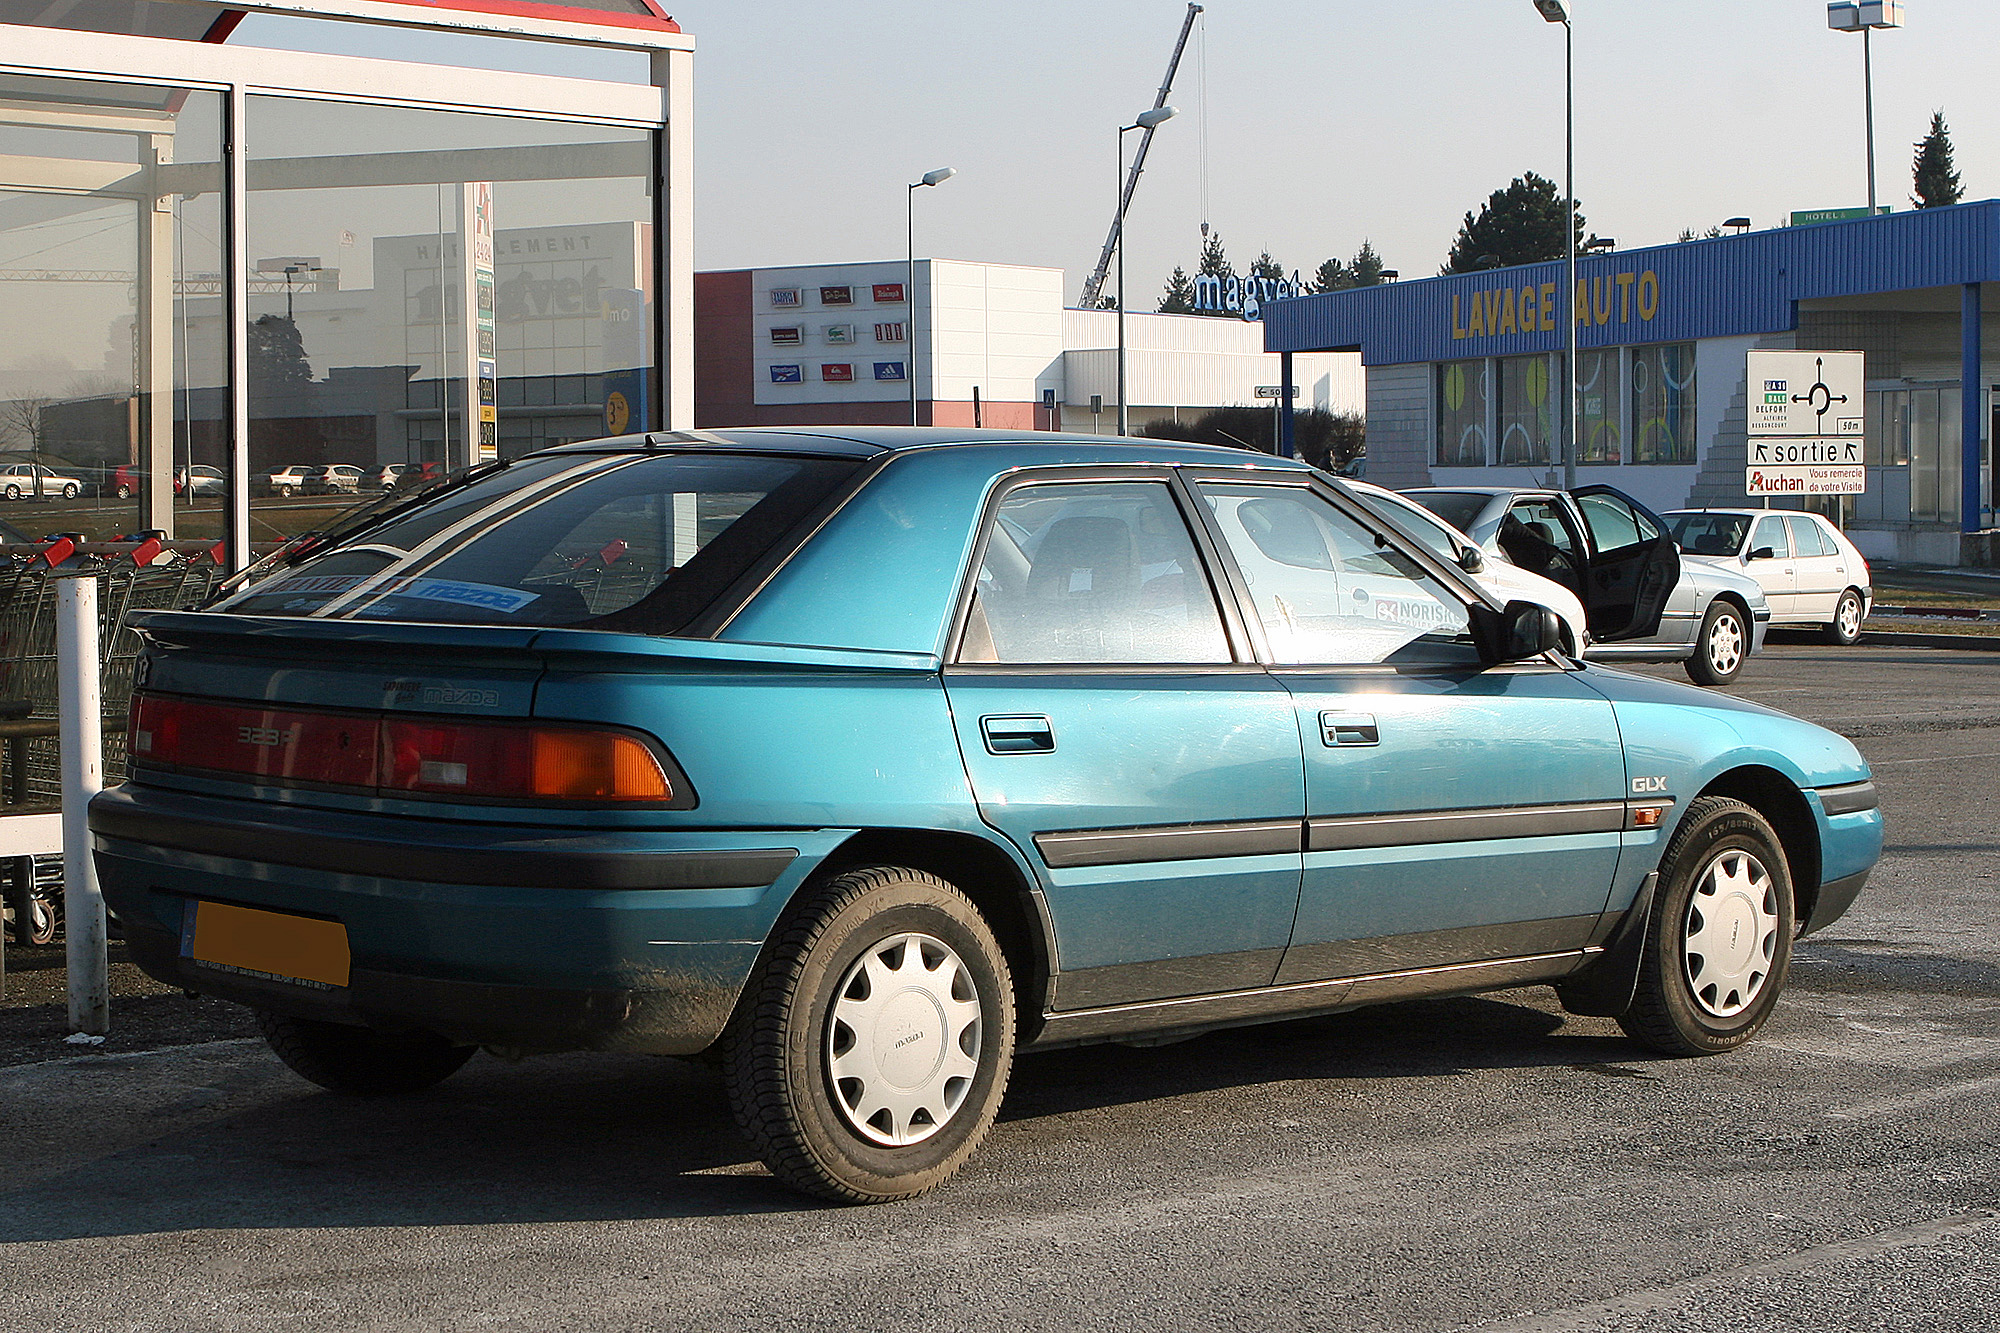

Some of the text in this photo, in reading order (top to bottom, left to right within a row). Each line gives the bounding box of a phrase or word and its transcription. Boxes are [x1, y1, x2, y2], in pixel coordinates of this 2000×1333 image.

[1805, 212, 1838, 221] HOTEL
[417, 236, 591, 260] HALEMENT
[1194, 269, 1302, 321] magvet
[1452, 270, 1659, 340] LAVAGE AUTO
[1755, 405, 1787, 413] BELFORT
[1774, 440, 1838, 463] sortie
[1749, 471, 1804, 492] Auchan
[1809, 469, 1829, 478] Vous
[1809, 482, 1863, 492] de votre Visite
[1632, 776, 1667, 793] GLX
